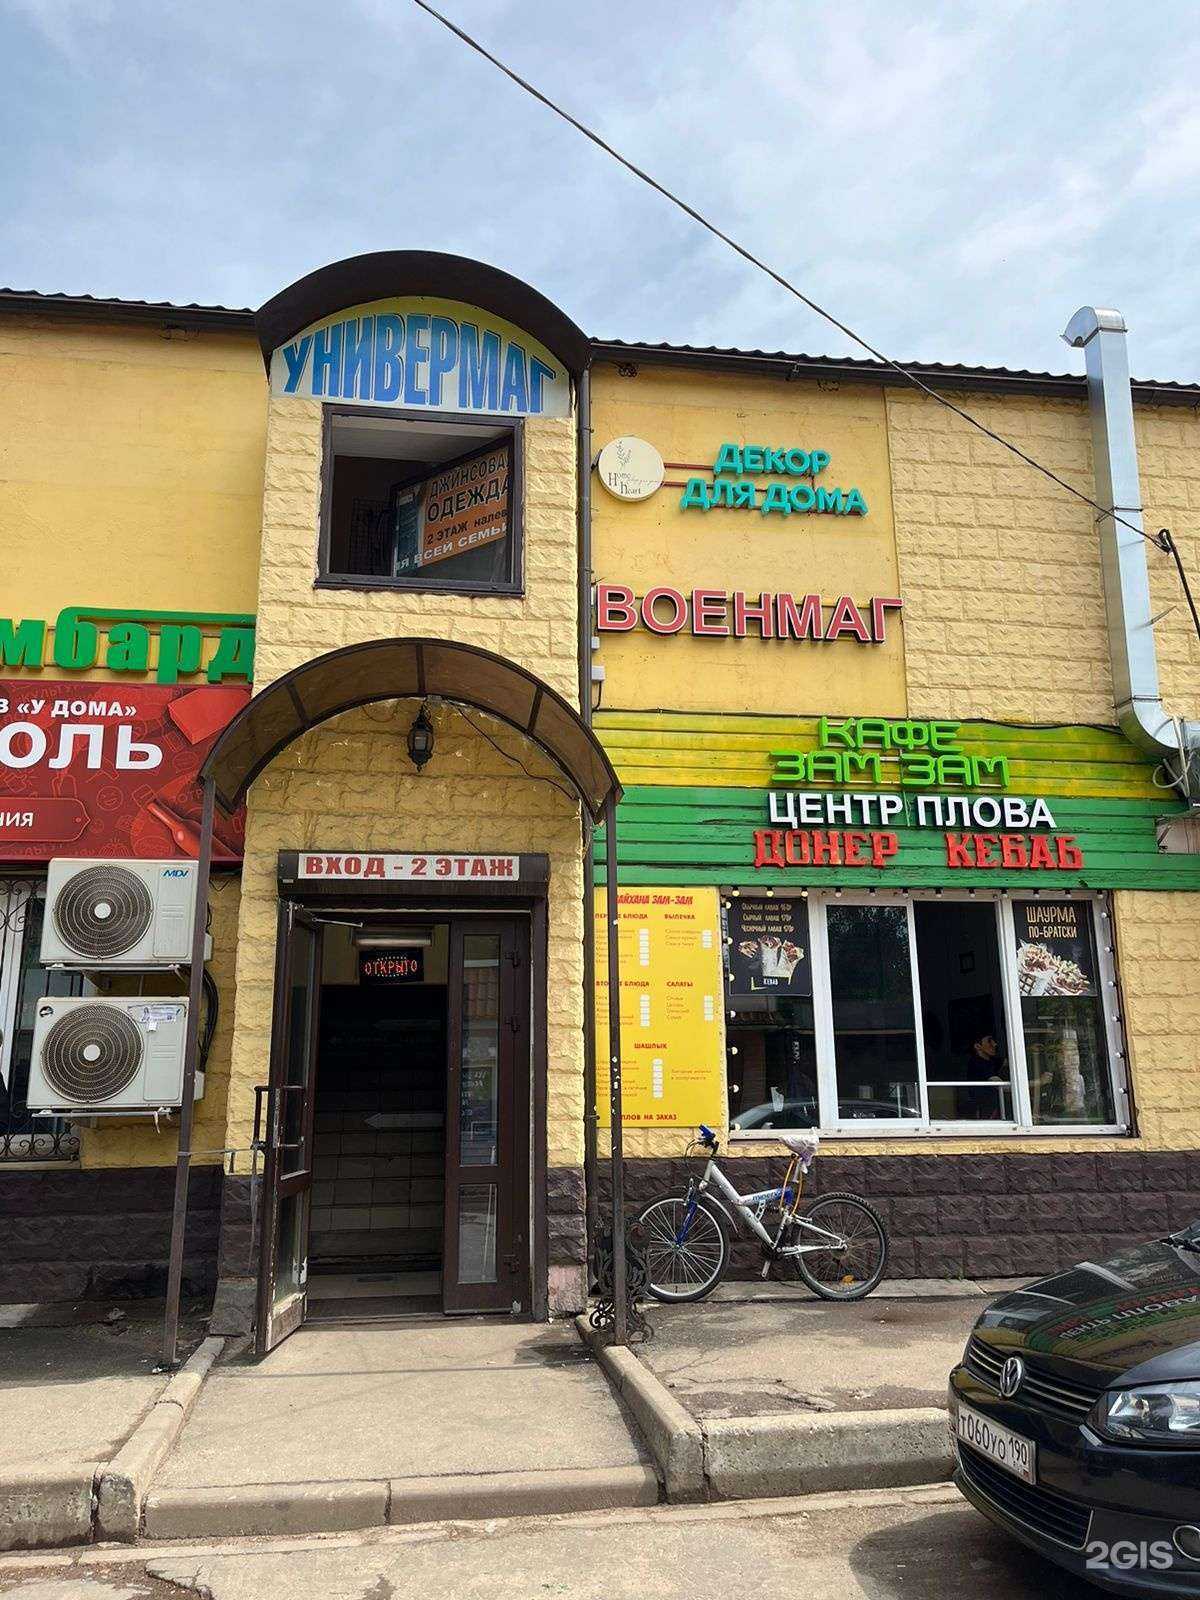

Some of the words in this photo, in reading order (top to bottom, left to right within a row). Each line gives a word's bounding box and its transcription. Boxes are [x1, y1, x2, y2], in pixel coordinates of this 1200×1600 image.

[282, 313, 556, 414] УНИВЕРМАГ
[713, 443, 831, 476] ДЕКОР
[680, 478, 755, 512] ДЛЯ
[761, 483, 868, 517] ДОМА
[437, 521, 468, 541] ЭТАЖ
[597, 583, 903, 643] ВОЕНМАГ
[51, 699, 137, 718] ДОМА»
[818, 716, 964, 754] КАФЕ
[770, 750, 882, 785] ЗАМ
[901, 753, 1010, 788] ЗАМ
[768, 792, 902, 829] ЦЕНТР
[917, 795, 1057, 828] ПЛОВА
[305, 856, 386, 878] ВХОД
[411, 858, 427, 876] 2
[435, 859, 513, 877] ЭТАЖ
[754, 830, 899, 868] ДОНЕР
[944, 832, 1084, 869] КЕБАБ
[1026, 906, 1077, 923] ШАУРМА
[1028, 925, 1077, 938] ПО-БРАТСКИ
[365, 958, 418, 975] ОТКРЫТО
